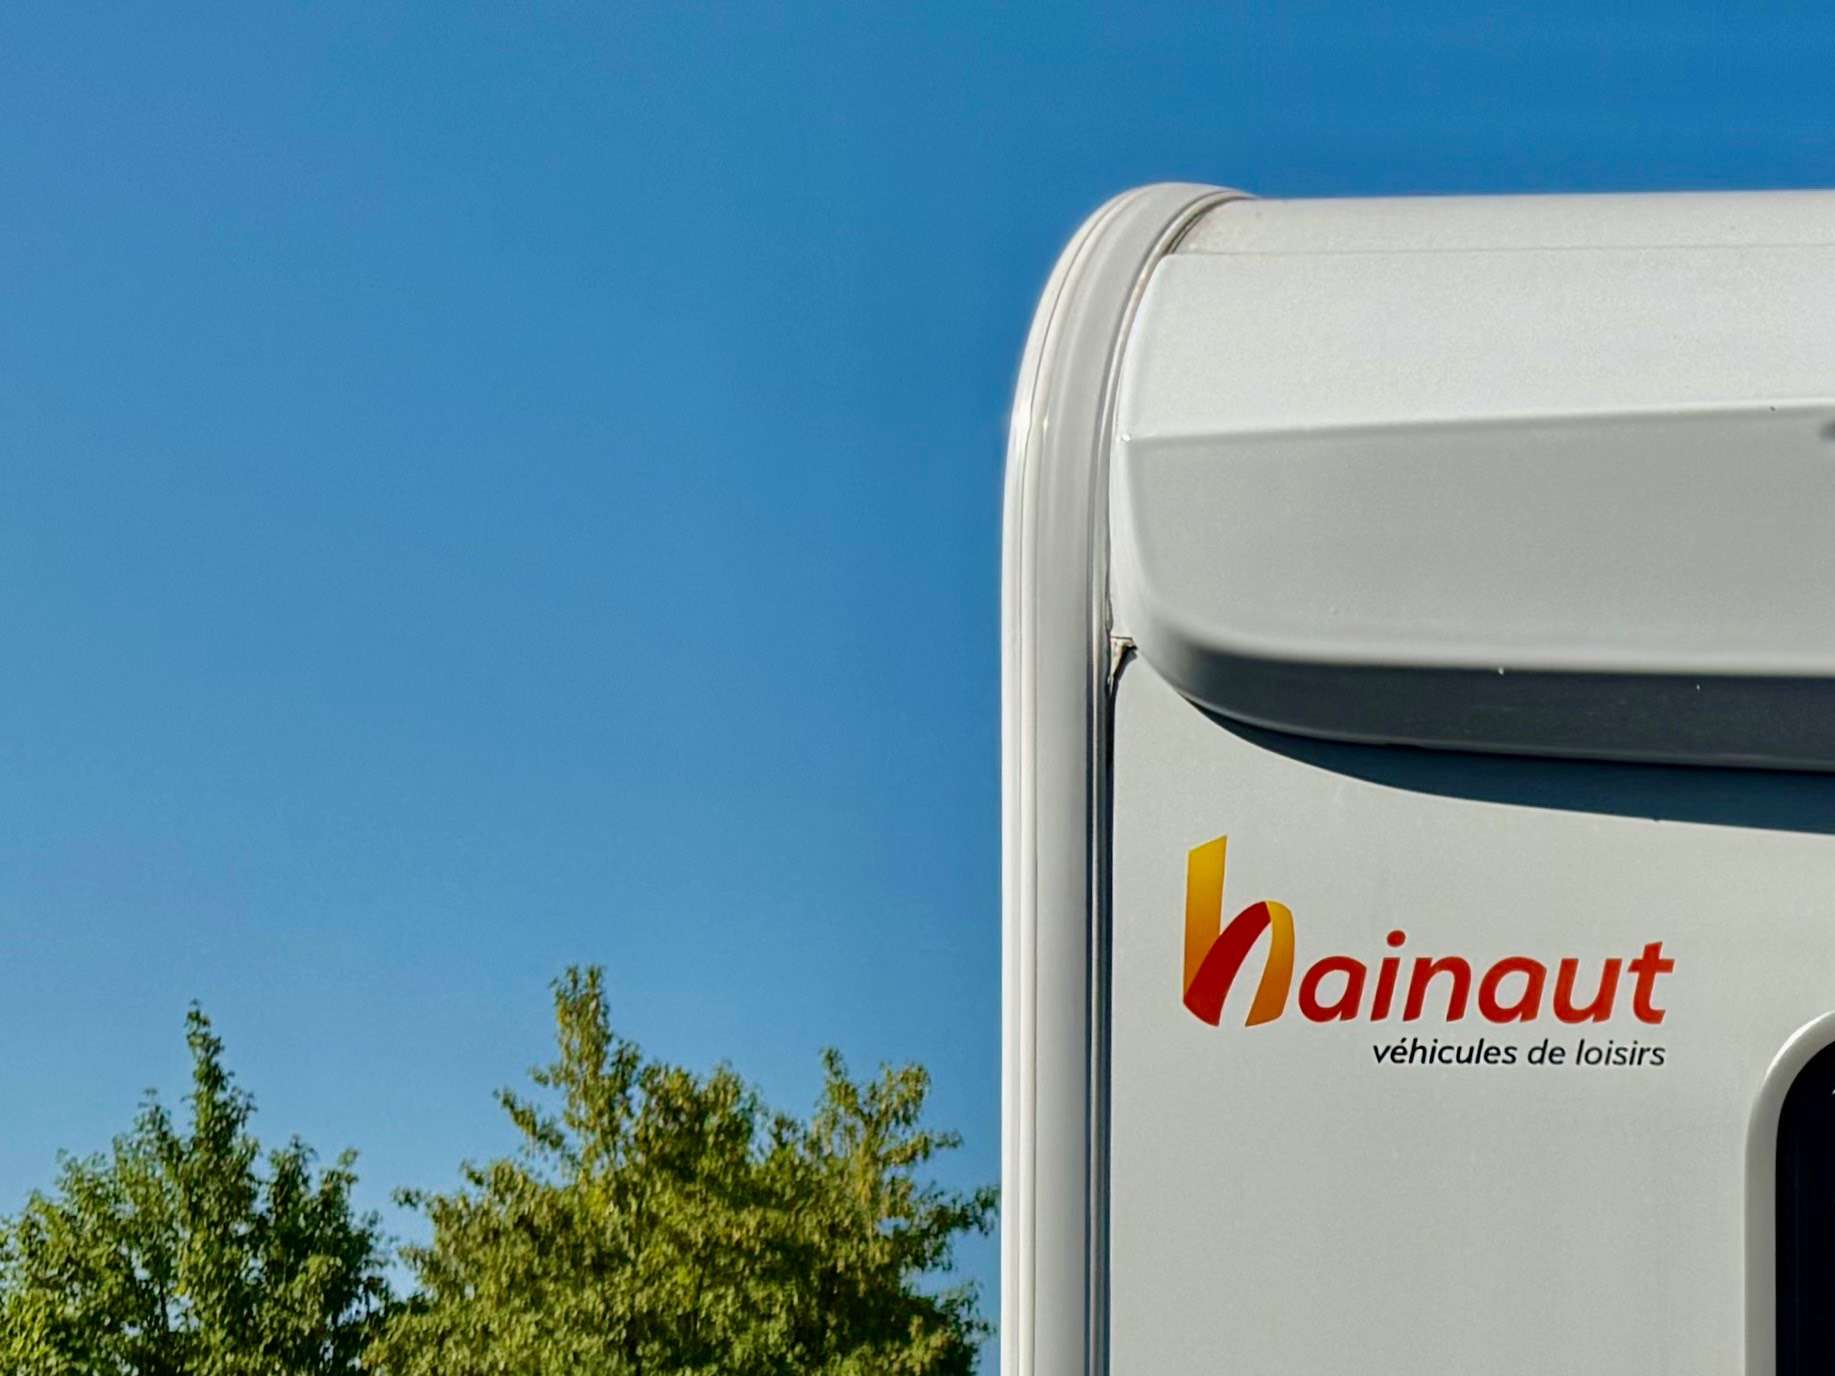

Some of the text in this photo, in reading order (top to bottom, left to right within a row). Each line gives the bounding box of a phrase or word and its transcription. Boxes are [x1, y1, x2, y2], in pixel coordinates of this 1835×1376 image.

[1182, 835, 1674, 1027] hainaut
[1372, 1036, 1666, 1067] véhicules de loisirs
